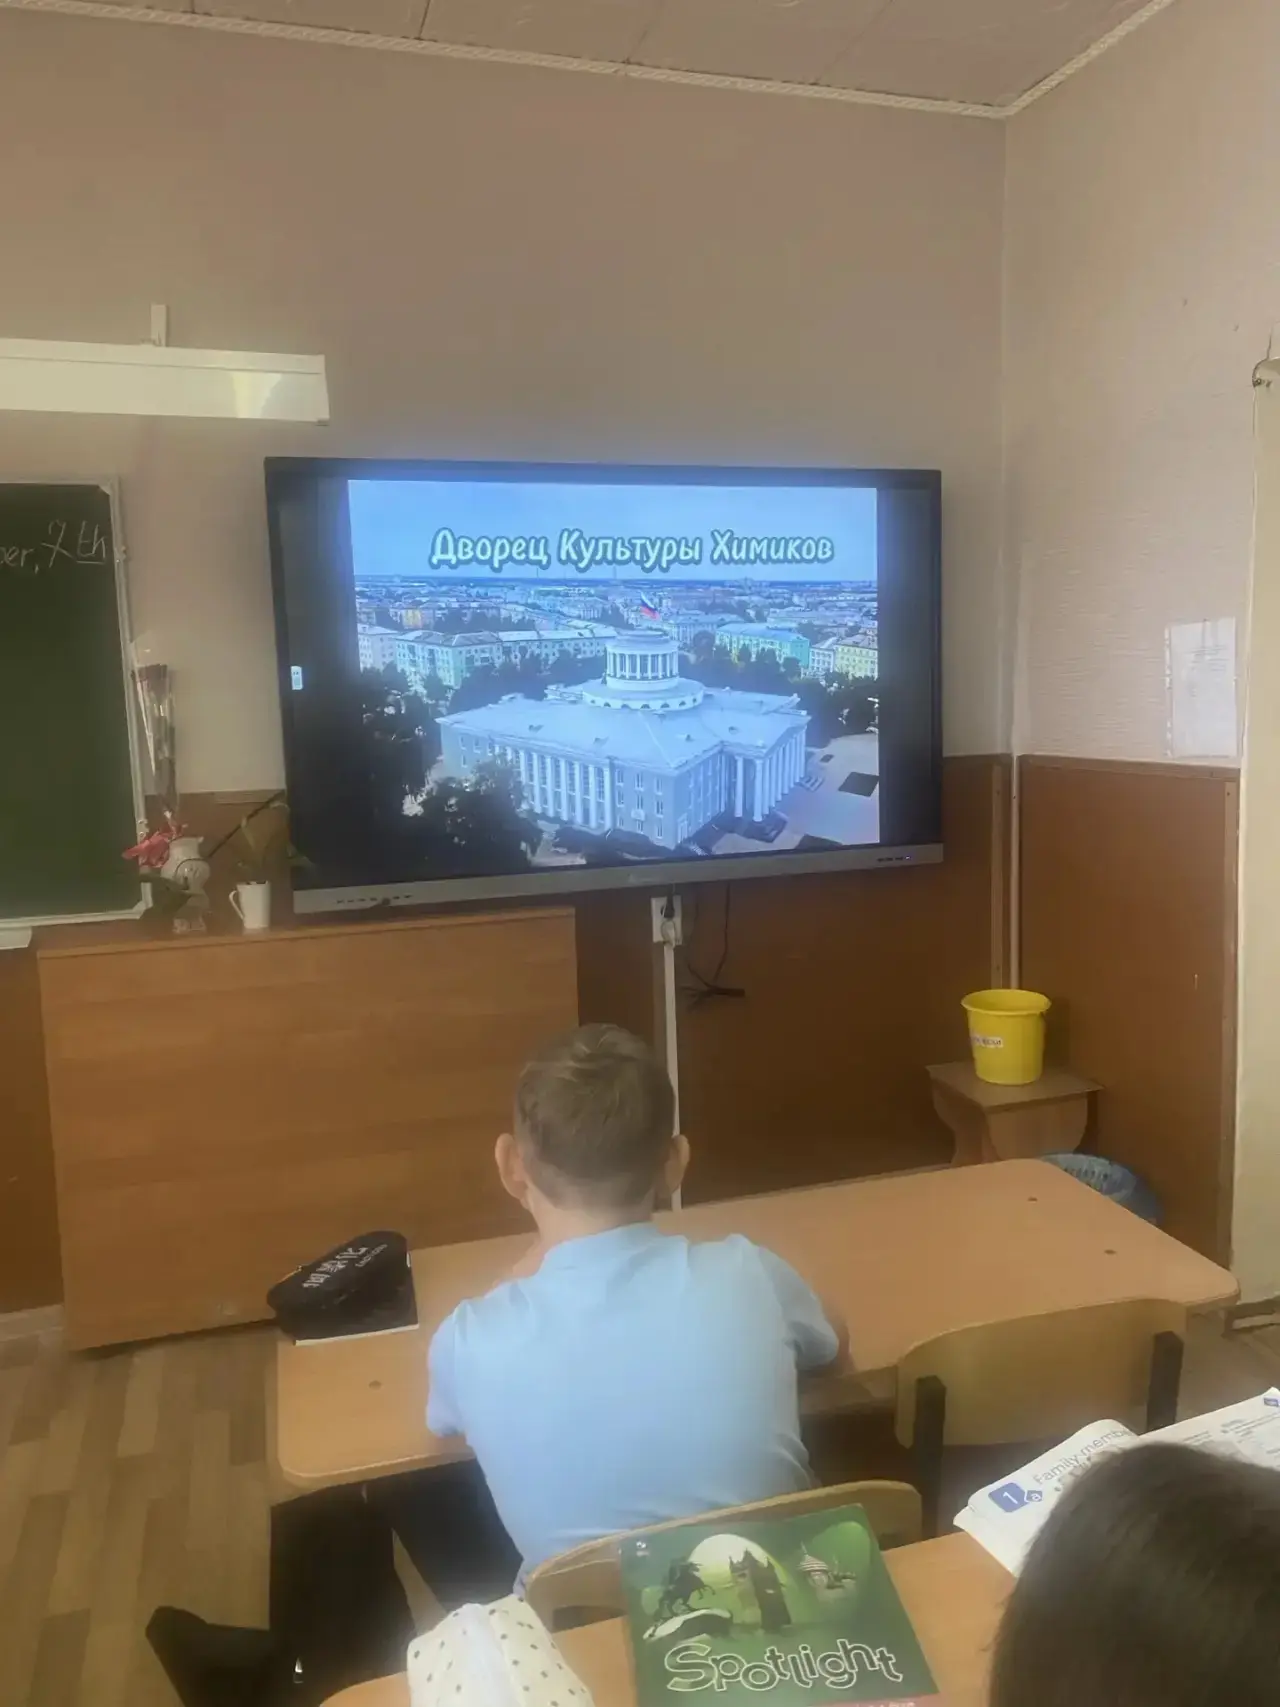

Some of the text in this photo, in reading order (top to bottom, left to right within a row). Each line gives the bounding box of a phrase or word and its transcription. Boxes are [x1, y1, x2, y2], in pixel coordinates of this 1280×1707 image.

[429, 527, 835, 572] Дворец Культуры Химиков
[1033, 1455, 1080, 1484] Family
[1002, 1491, 1018, 1505] 1
[664, 1638, 903, 1692] Spotlight
